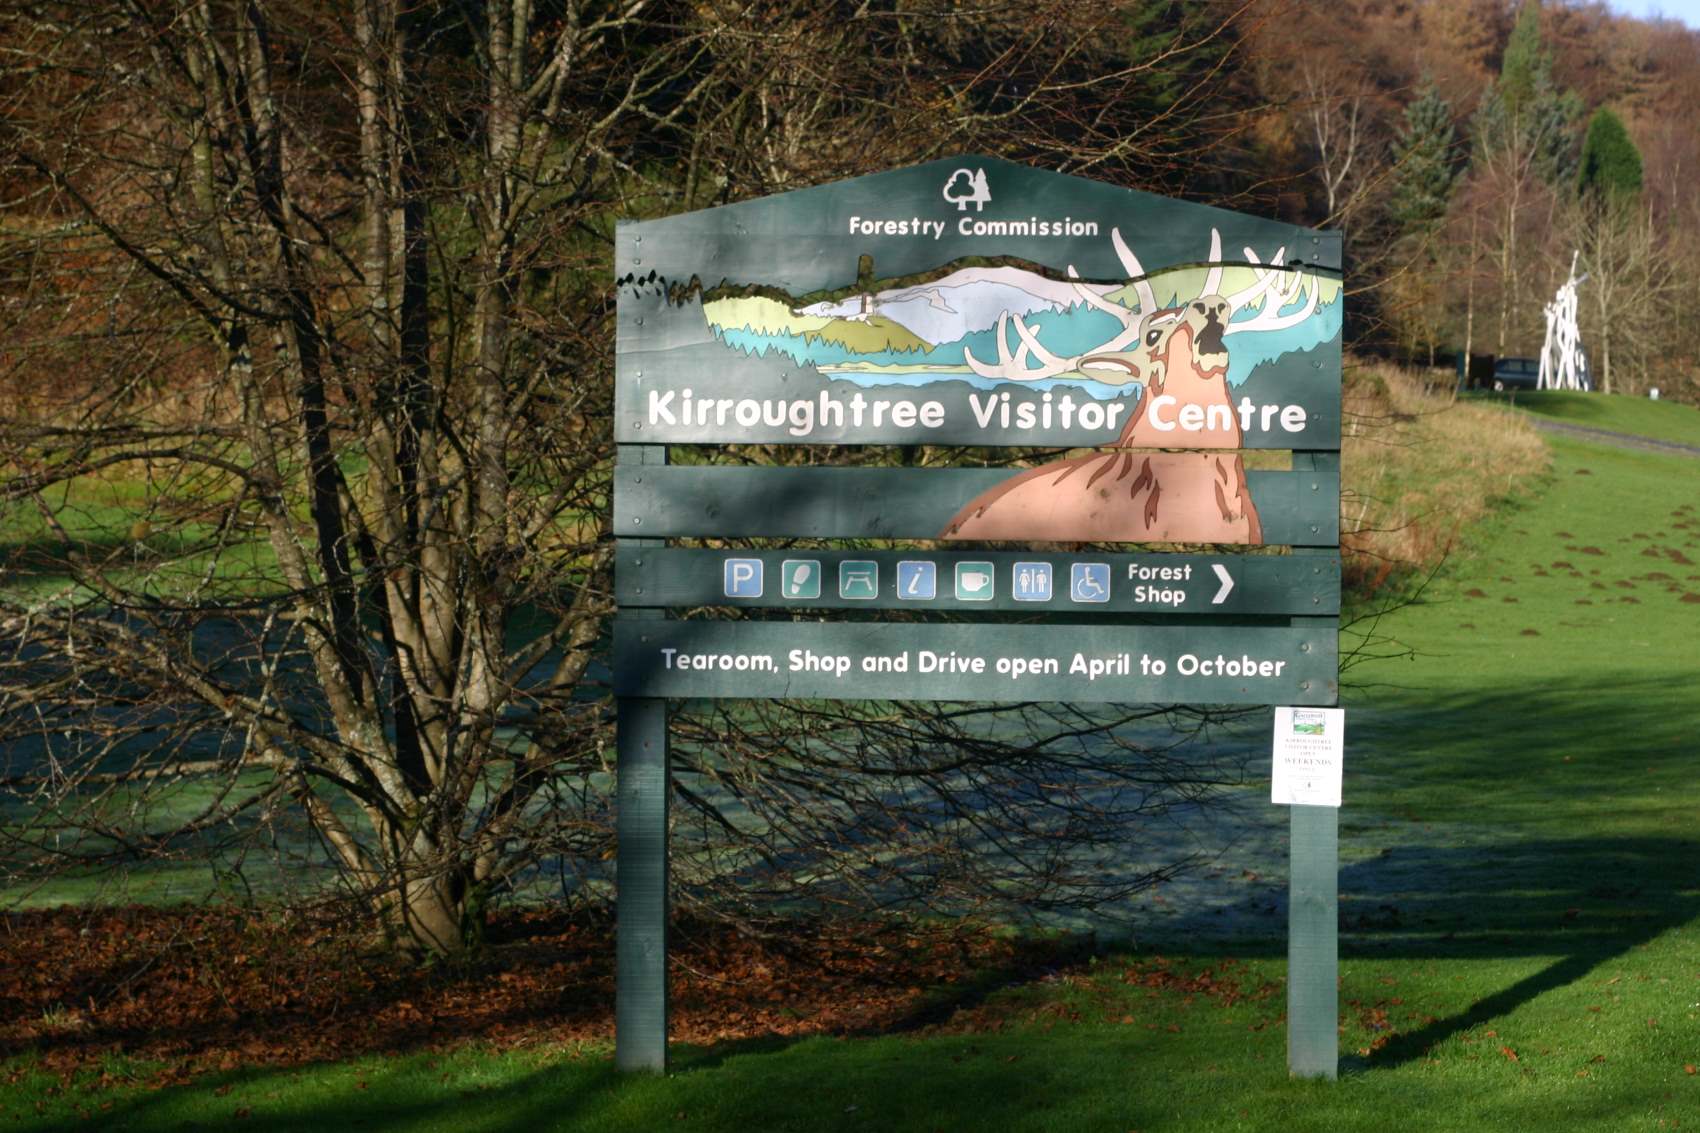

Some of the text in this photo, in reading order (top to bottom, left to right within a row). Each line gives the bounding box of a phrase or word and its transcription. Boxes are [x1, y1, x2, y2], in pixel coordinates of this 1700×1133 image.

[849, 216, 1098, 239] Forestry Commission
[649, 388, 1305, 440] Kirroughtree Visitor Centre
[734, 563, 753, 592] P
[908, 567, 922, 594] i
[1129, 564, 1192, 580] Forest
[1135, 585, 1185, 607] Shop
[661, 648, 1285, 680] Tearoom, Shop and Drive open April to October
